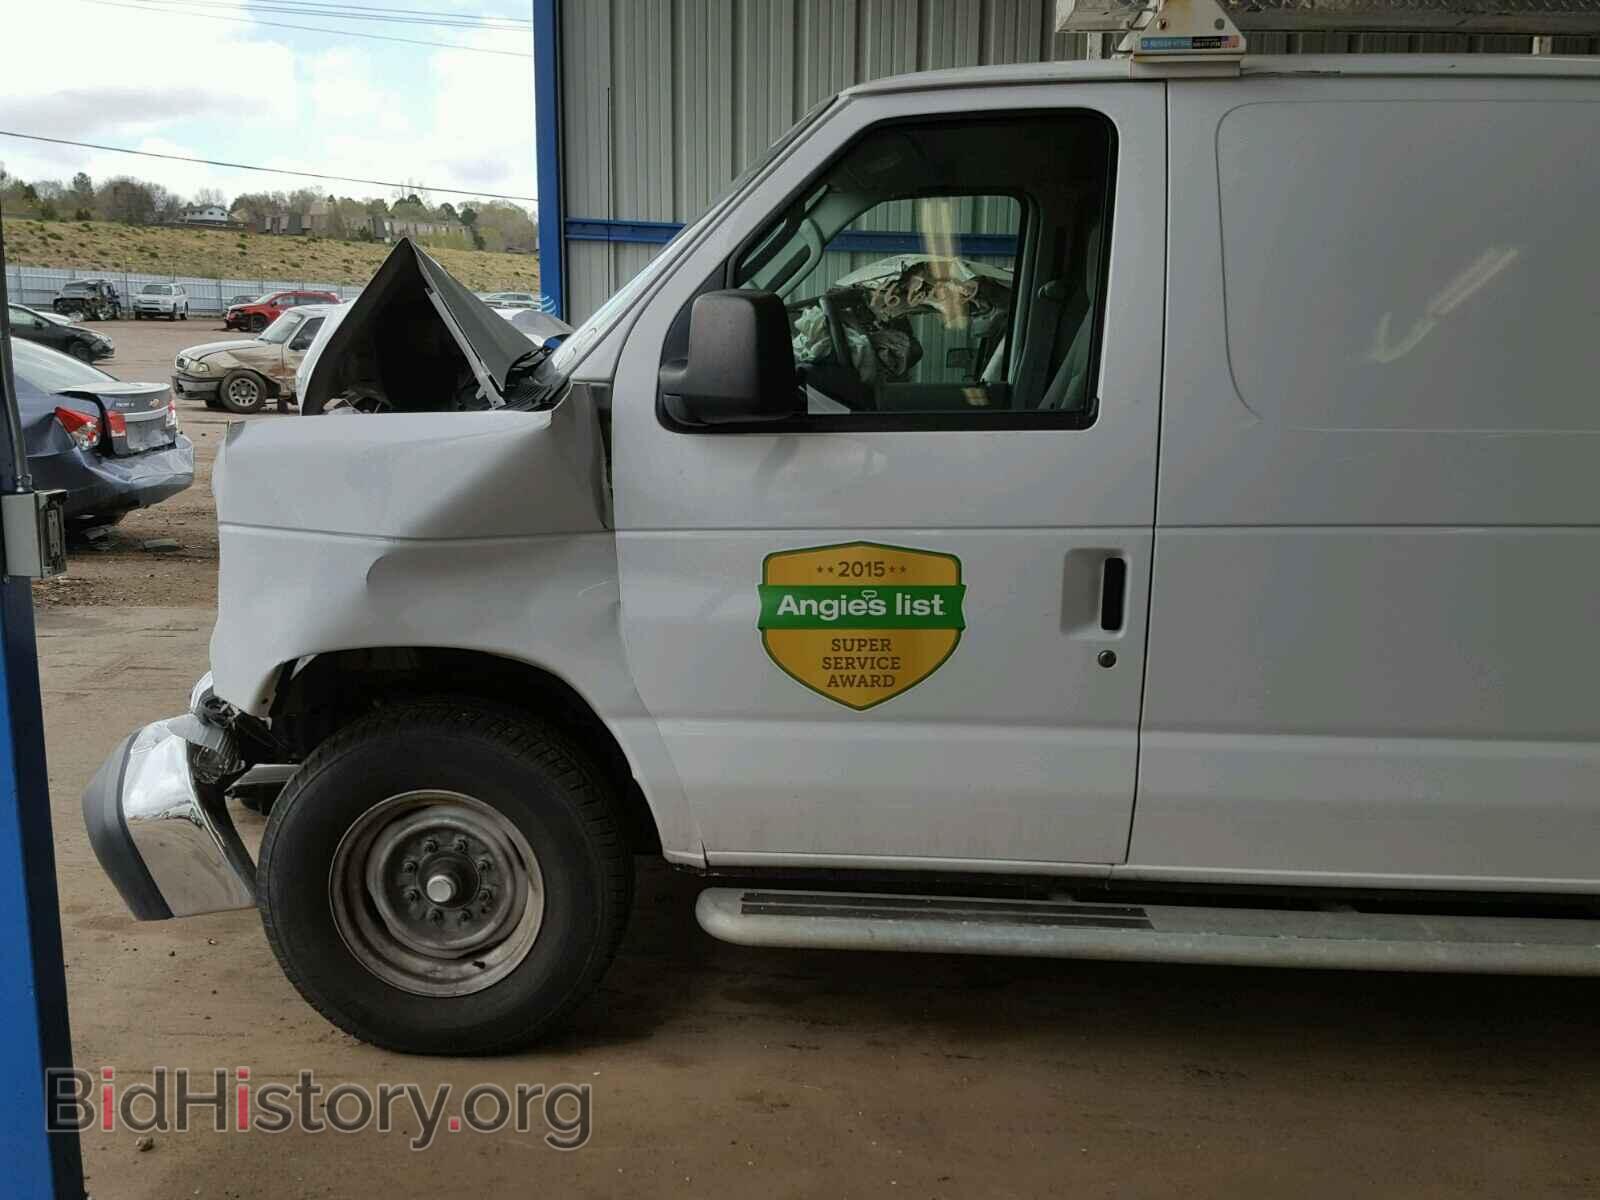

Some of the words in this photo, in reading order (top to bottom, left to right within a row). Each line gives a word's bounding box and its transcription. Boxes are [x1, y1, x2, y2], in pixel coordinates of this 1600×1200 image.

[838, 561, 886, 577] 2015
[895, 593, 945, 616] list
[831, 638, 892, 652] SUPER
[821, 656, 902, 670] SERVICE
[827, 674, 896, 688] AWARD
